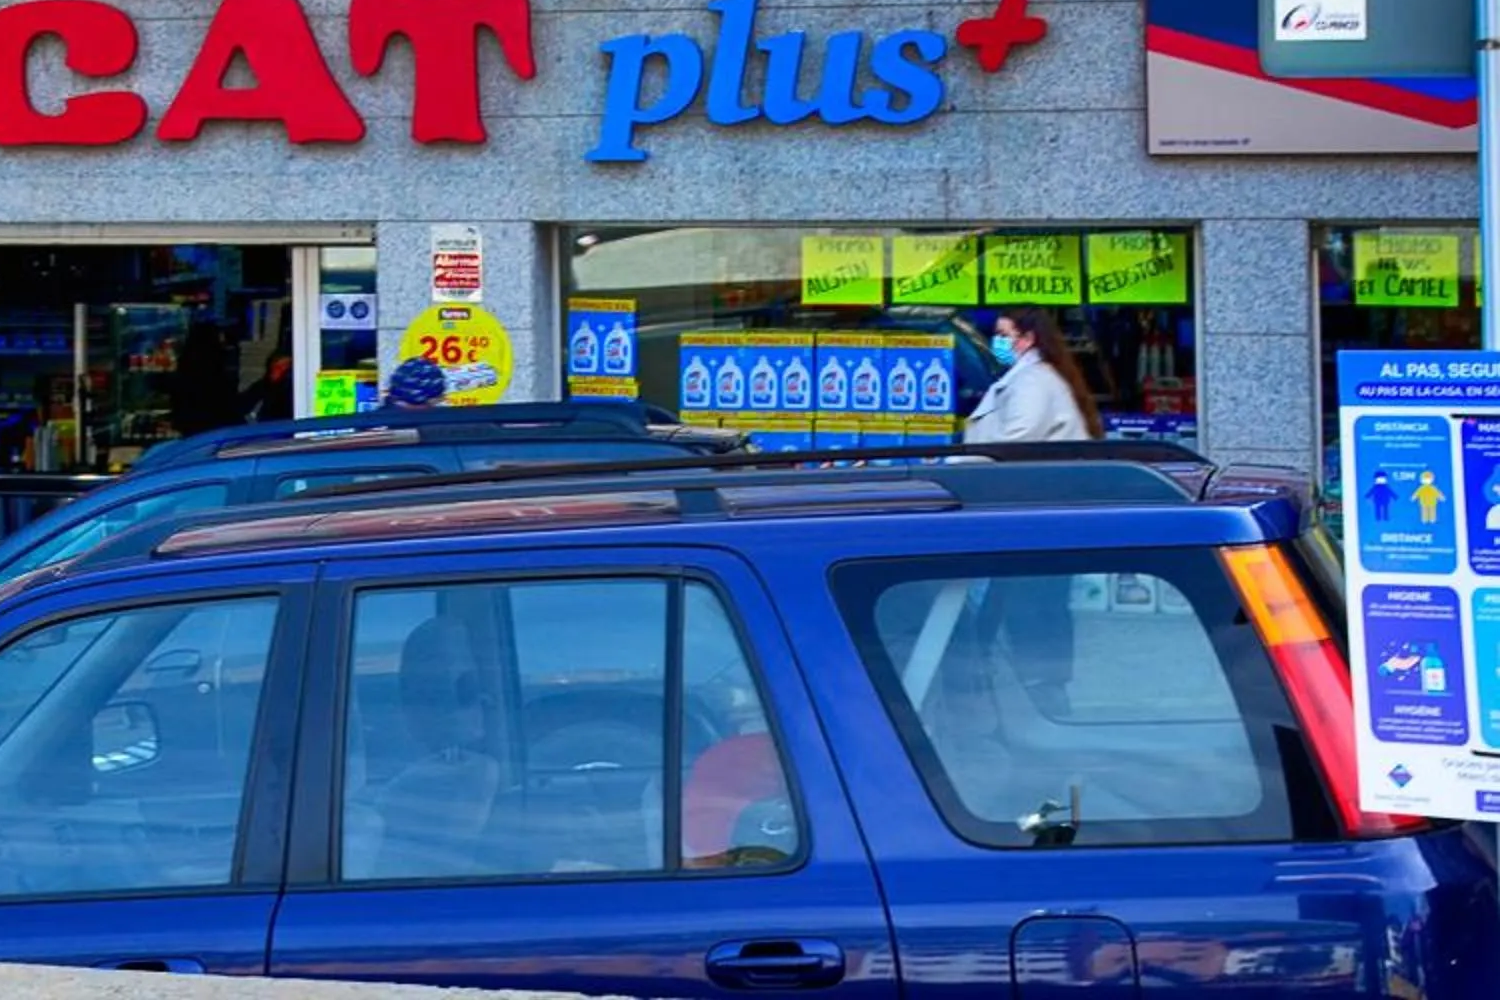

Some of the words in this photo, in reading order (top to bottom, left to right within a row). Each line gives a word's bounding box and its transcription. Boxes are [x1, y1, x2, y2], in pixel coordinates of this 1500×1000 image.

[993, 250, 1064, 270] TABAC
[1384, 273, 1452, 299] CAMEL
[419, 335, 463, 364] 26
[1380, 362, 1404, 378] AL
